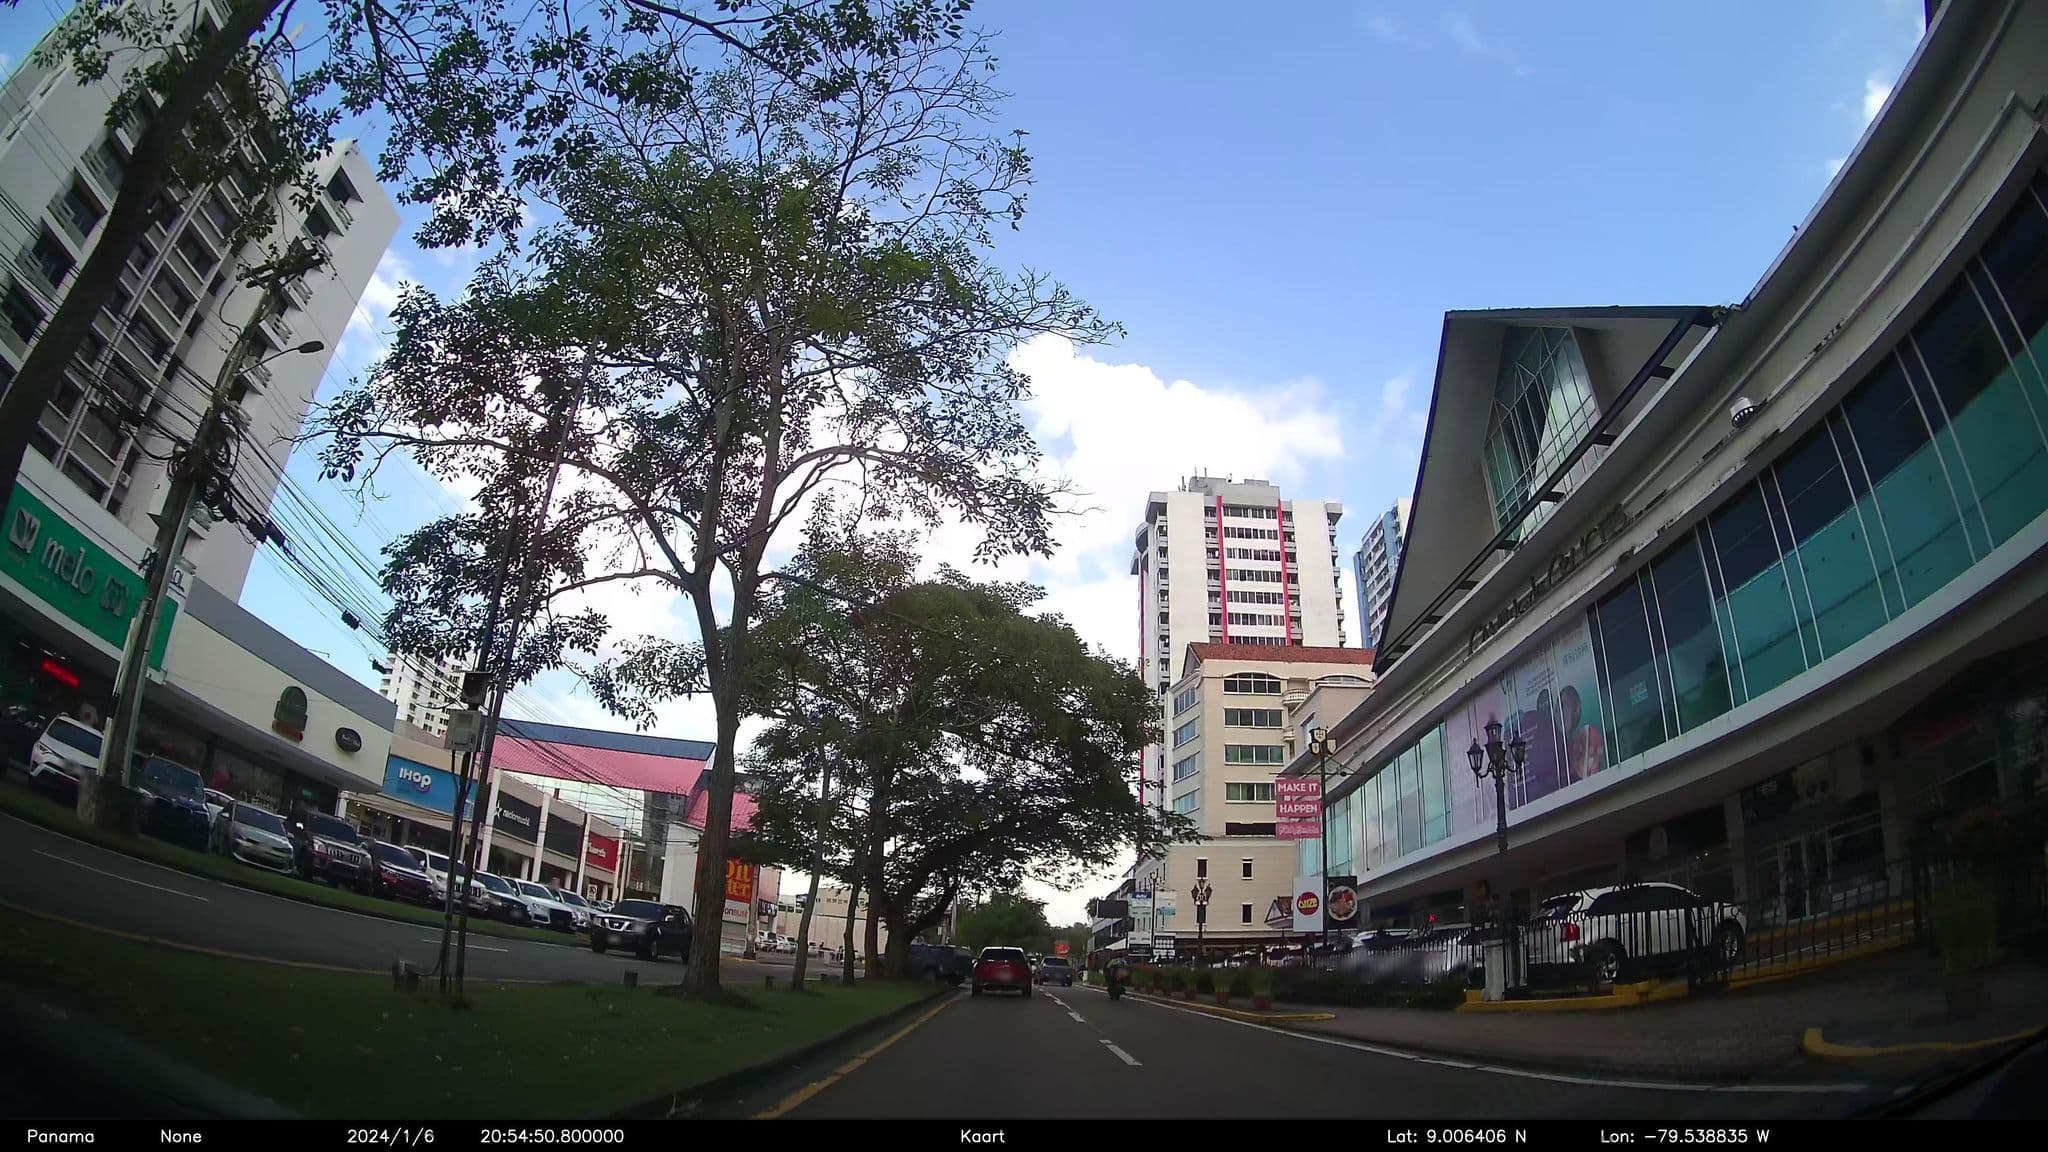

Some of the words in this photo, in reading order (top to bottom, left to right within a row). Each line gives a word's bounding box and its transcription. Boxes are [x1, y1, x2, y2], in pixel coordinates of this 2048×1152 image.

[40, 538, 96, 595] melo
[1277, 783, 1306, 793] MAKE
[1308, 783, 1318, 792] IT
[1279, 804, 1318, 814] HAPPEN
